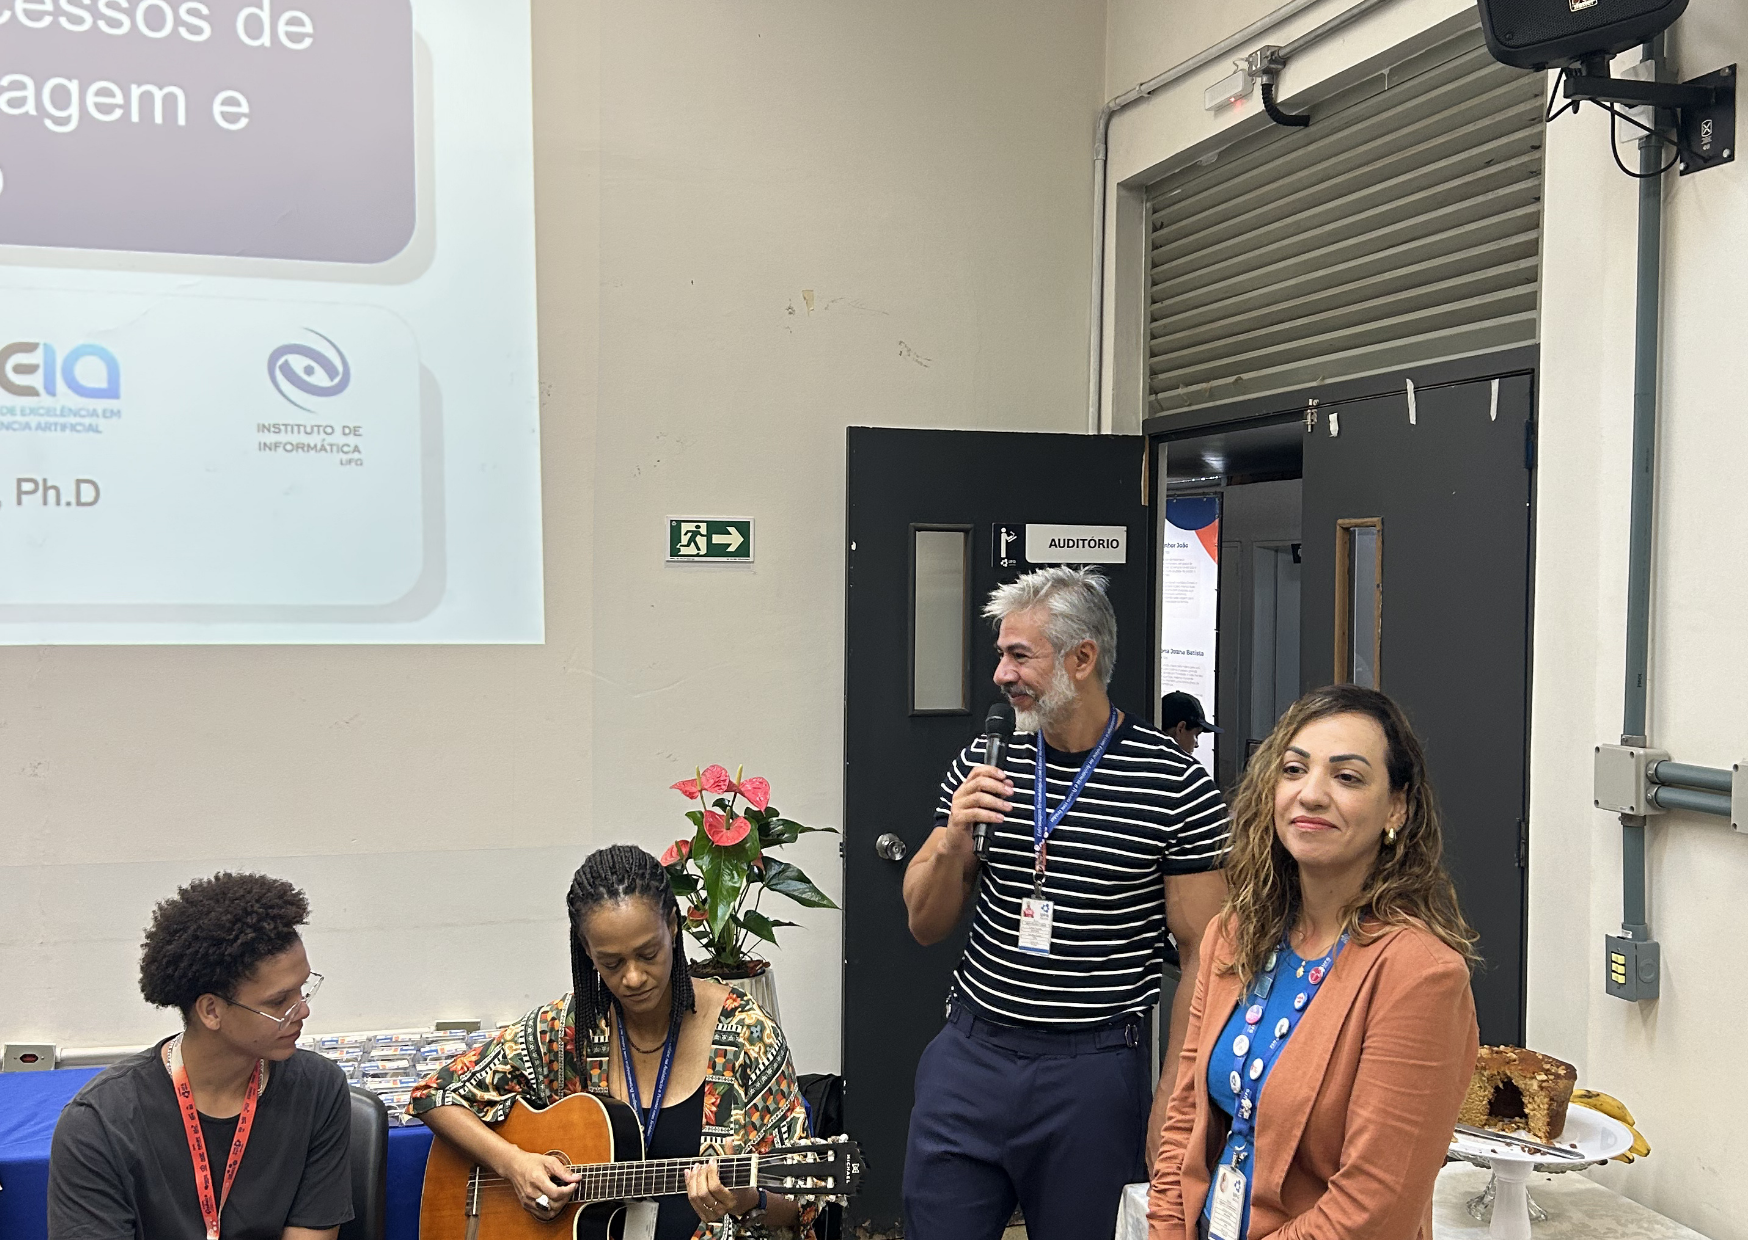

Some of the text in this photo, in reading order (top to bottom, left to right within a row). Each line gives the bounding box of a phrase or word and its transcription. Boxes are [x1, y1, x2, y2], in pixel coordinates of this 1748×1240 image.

[0, 0, 313, 50] essos de
[0, 73, 250, 133] agem e
[20, 405, 100, 418] EXCELÊNCIA
[102, 408, 121, 419] EM
[35, 421, 103, 434] ARTIFICIAL
[257, 423, 363, 437] INSTITUTO DE
[258, 438, 362, 455] INFORMÁTICA
[16, 477, 101, 507] Ph.D
[1048, 536, 1120, 549] AUDITÓRIO
